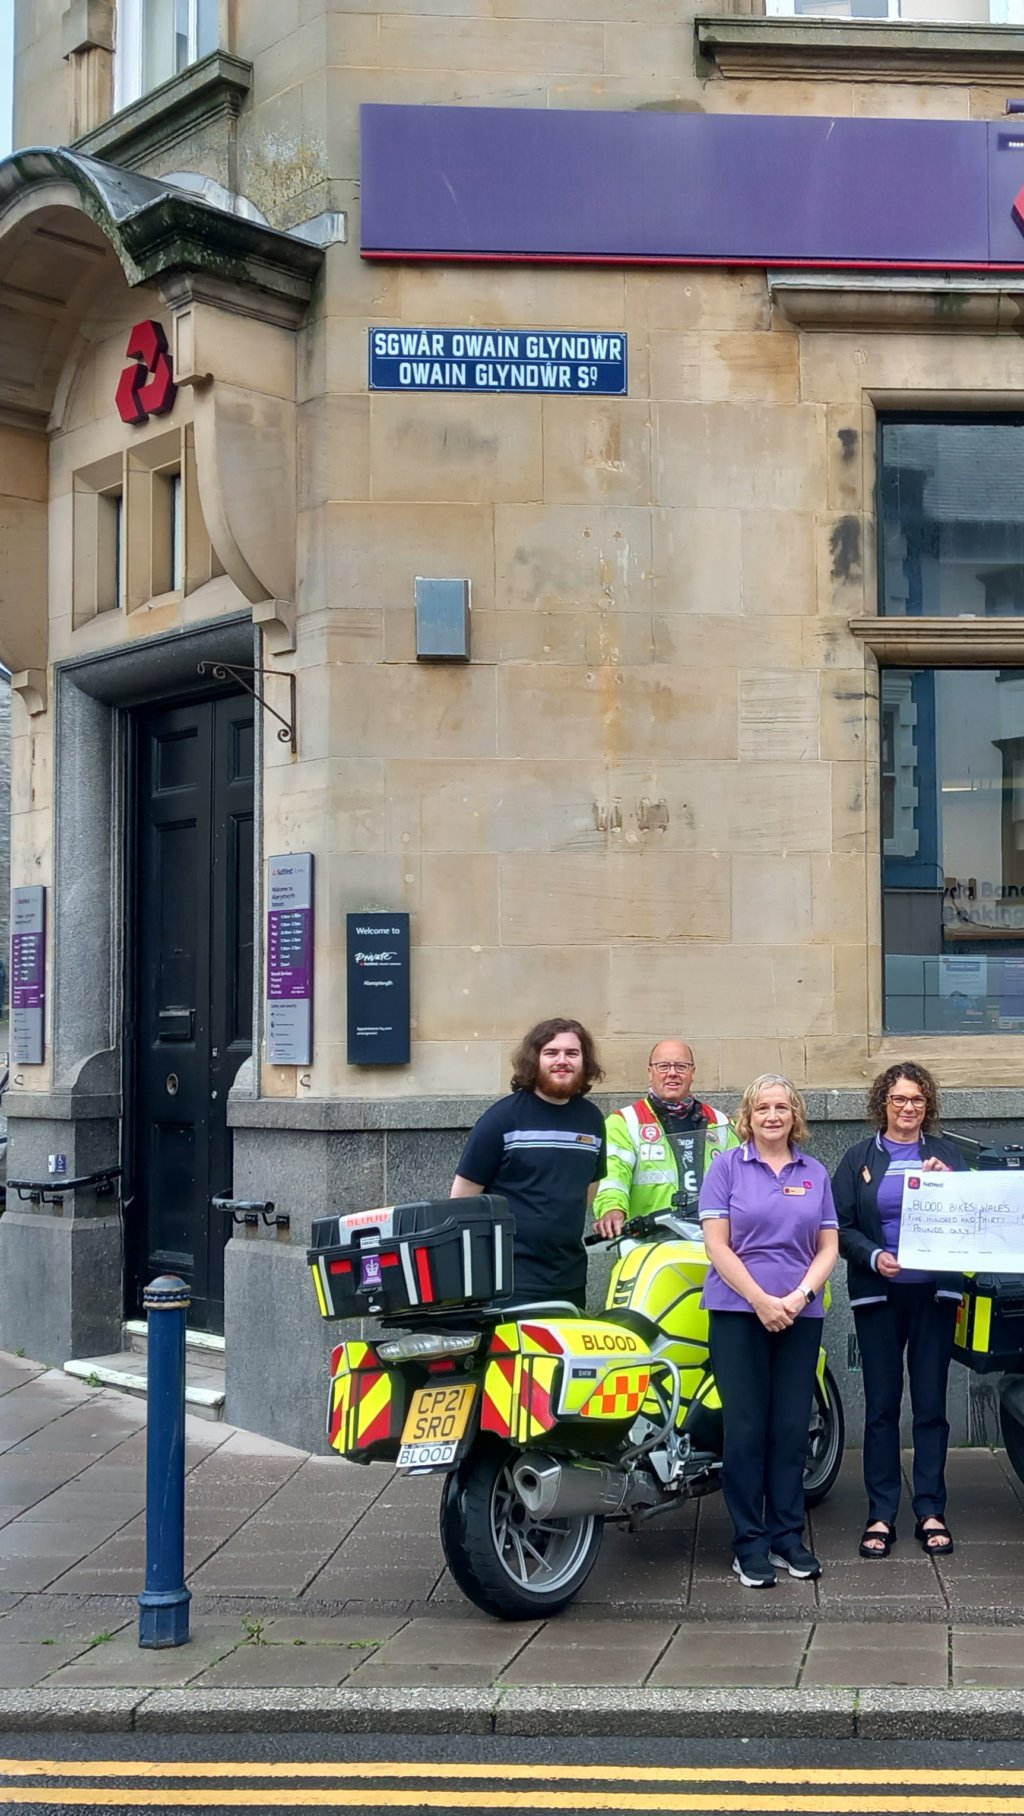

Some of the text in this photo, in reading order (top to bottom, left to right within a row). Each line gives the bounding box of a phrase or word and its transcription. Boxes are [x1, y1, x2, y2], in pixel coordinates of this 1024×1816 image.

[374, 330, 622, 360] SGWÂR OWAIN GLYNDŴR
[400, 362, 466, 385] OWAIN
[475, 361, 572, 388] GLYNDŴR
[356, 927, 401, 935] Welcome to
[912, 1200, 1011, 1213] BLOOD BIKES WALES
[580, 1334, 637, 1352] BLOOD
[417, 1388, 467, 1415] CP21
[412, 1414, 456, 1440] SRO
[399, 1446, 454, 1465] BLOOD
